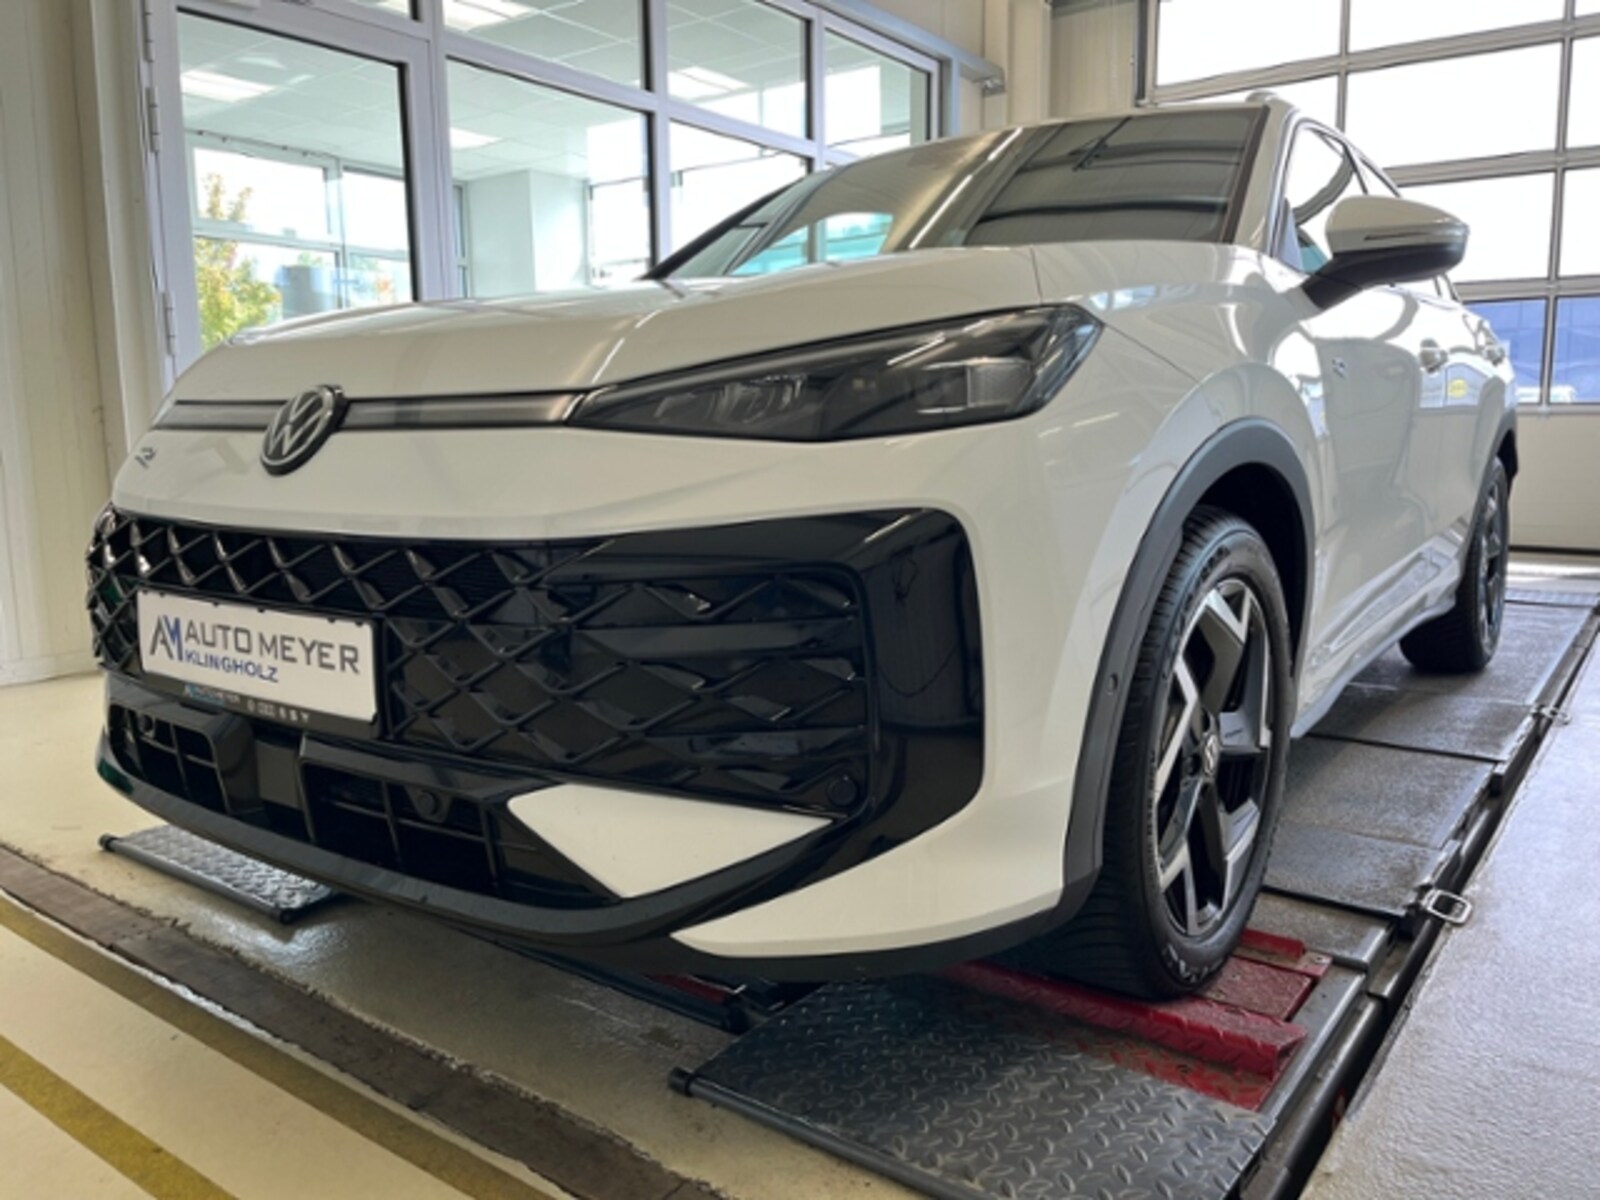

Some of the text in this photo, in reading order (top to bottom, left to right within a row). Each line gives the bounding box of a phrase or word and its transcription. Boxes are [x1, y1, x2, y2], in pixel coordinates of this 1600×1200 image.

[184, 648, 279, 683] KLINGHOLZ
[185, 619, 360, 675] AUTO MEYER
